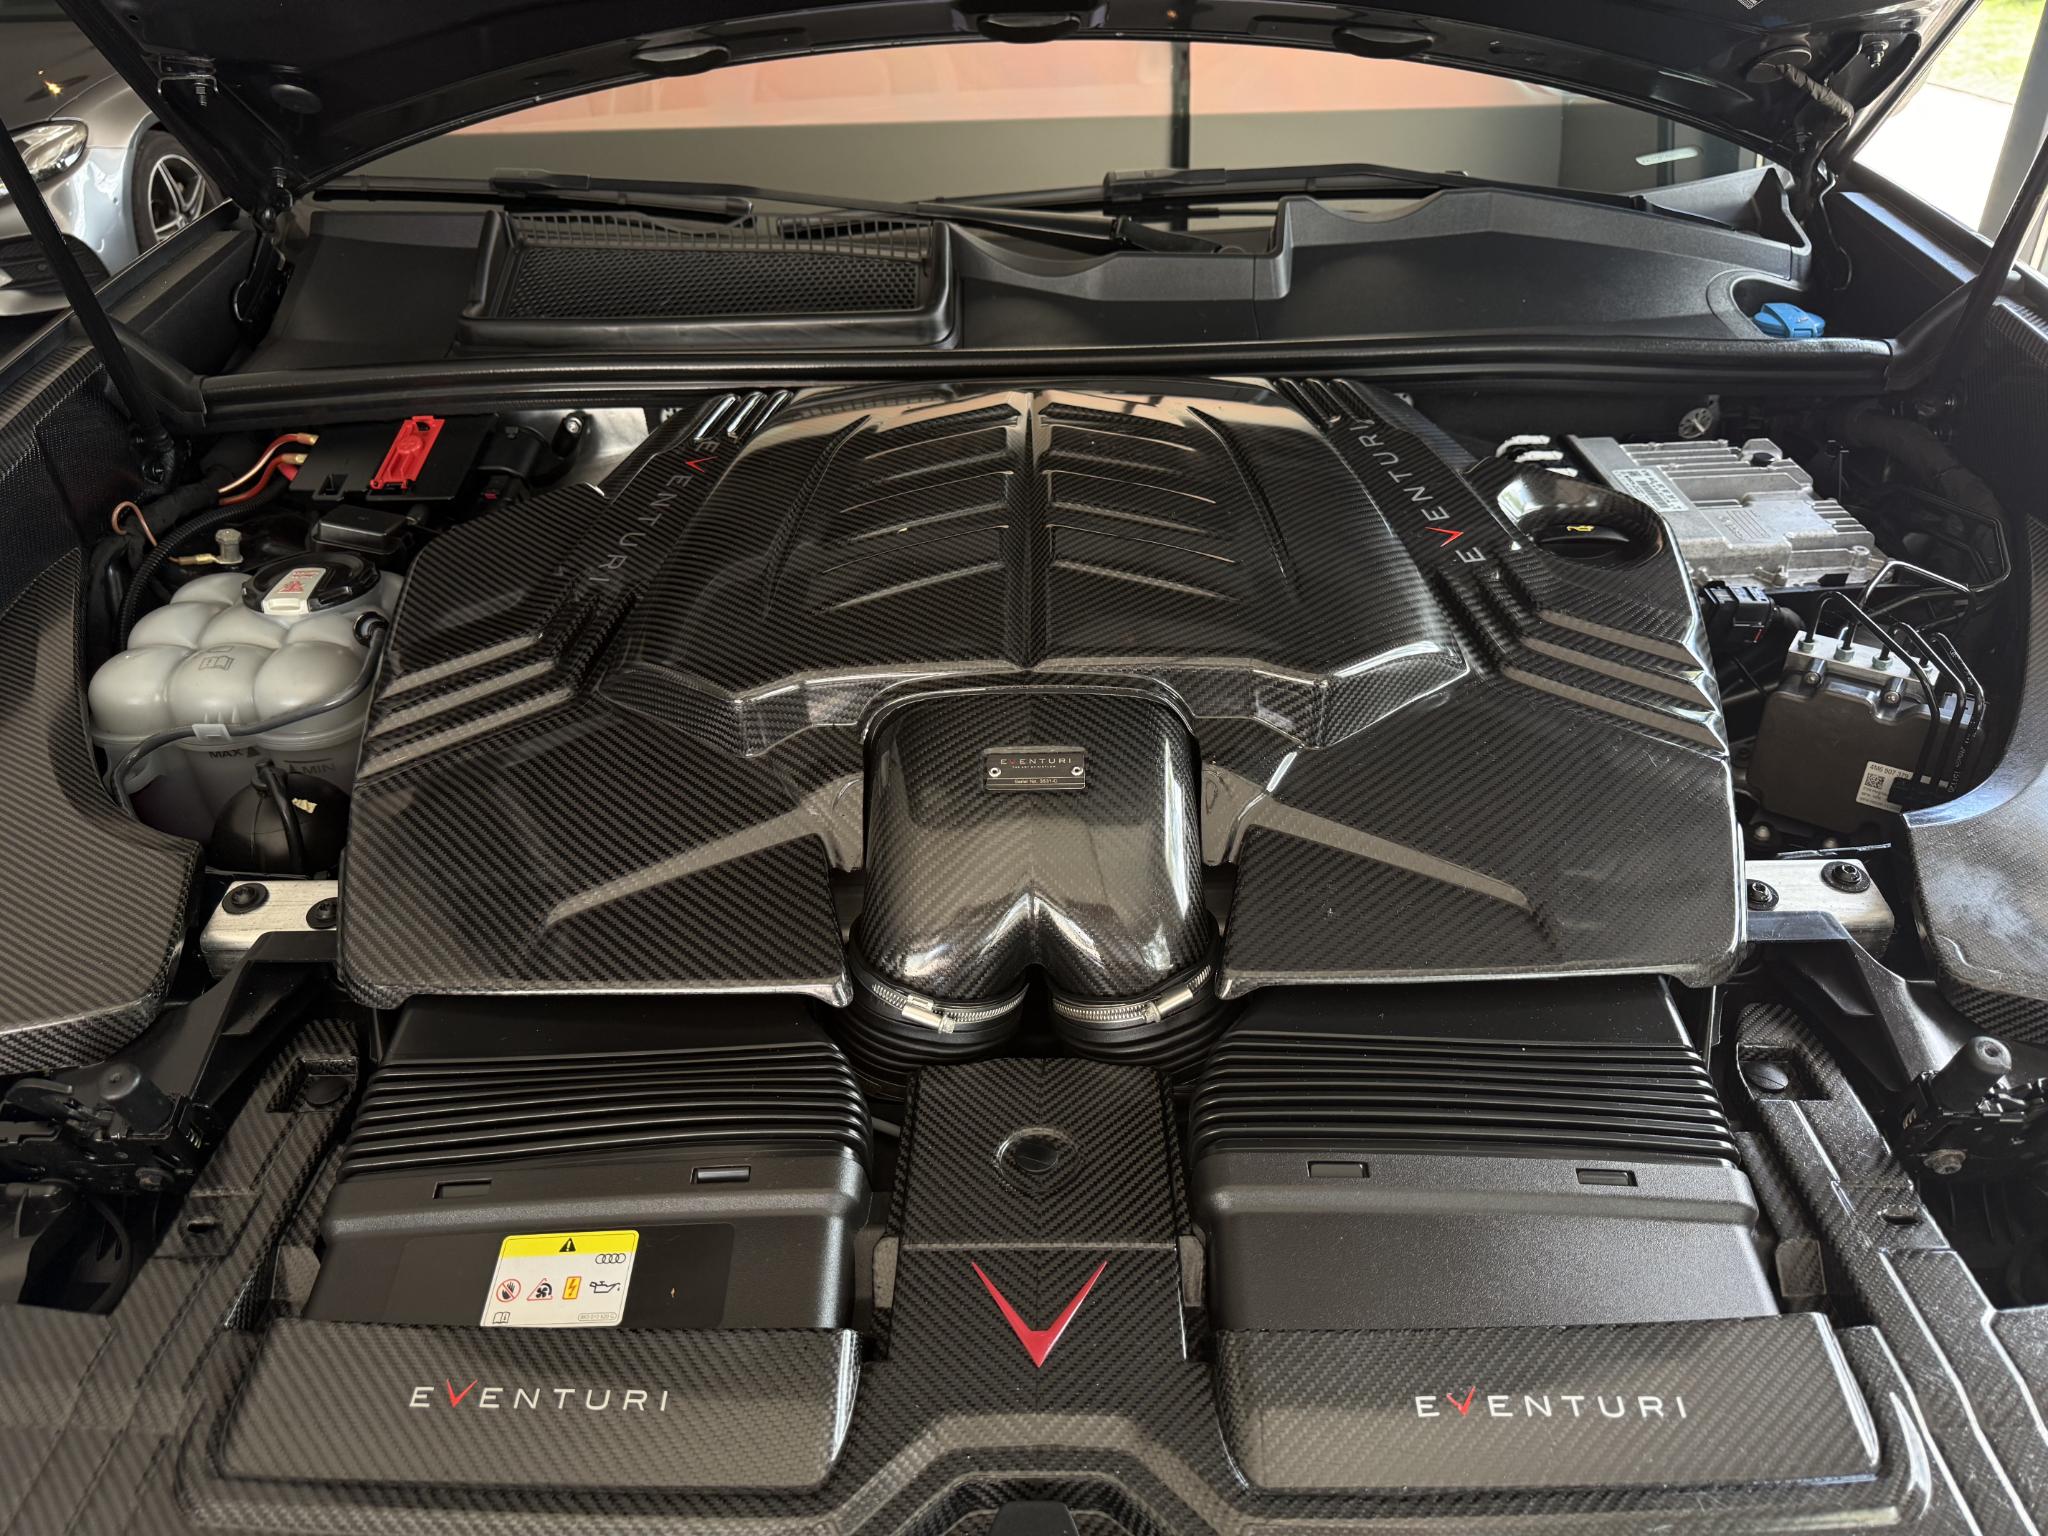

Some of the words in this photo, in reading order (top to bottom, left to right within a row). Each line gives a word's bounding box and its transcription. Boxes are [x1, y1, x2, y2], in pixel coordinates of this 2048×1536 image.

[589, 440, 720, 581] EVENTURI
[1350, 425, 1486, 563] EVENTURI
[209, 749, 243, 759] MAX
[303, 763, 337, 775] MIN
[409, 1378, 669, 1412] EVENTURI
[1415, 1385, 1687, 1418] EVENTURI
